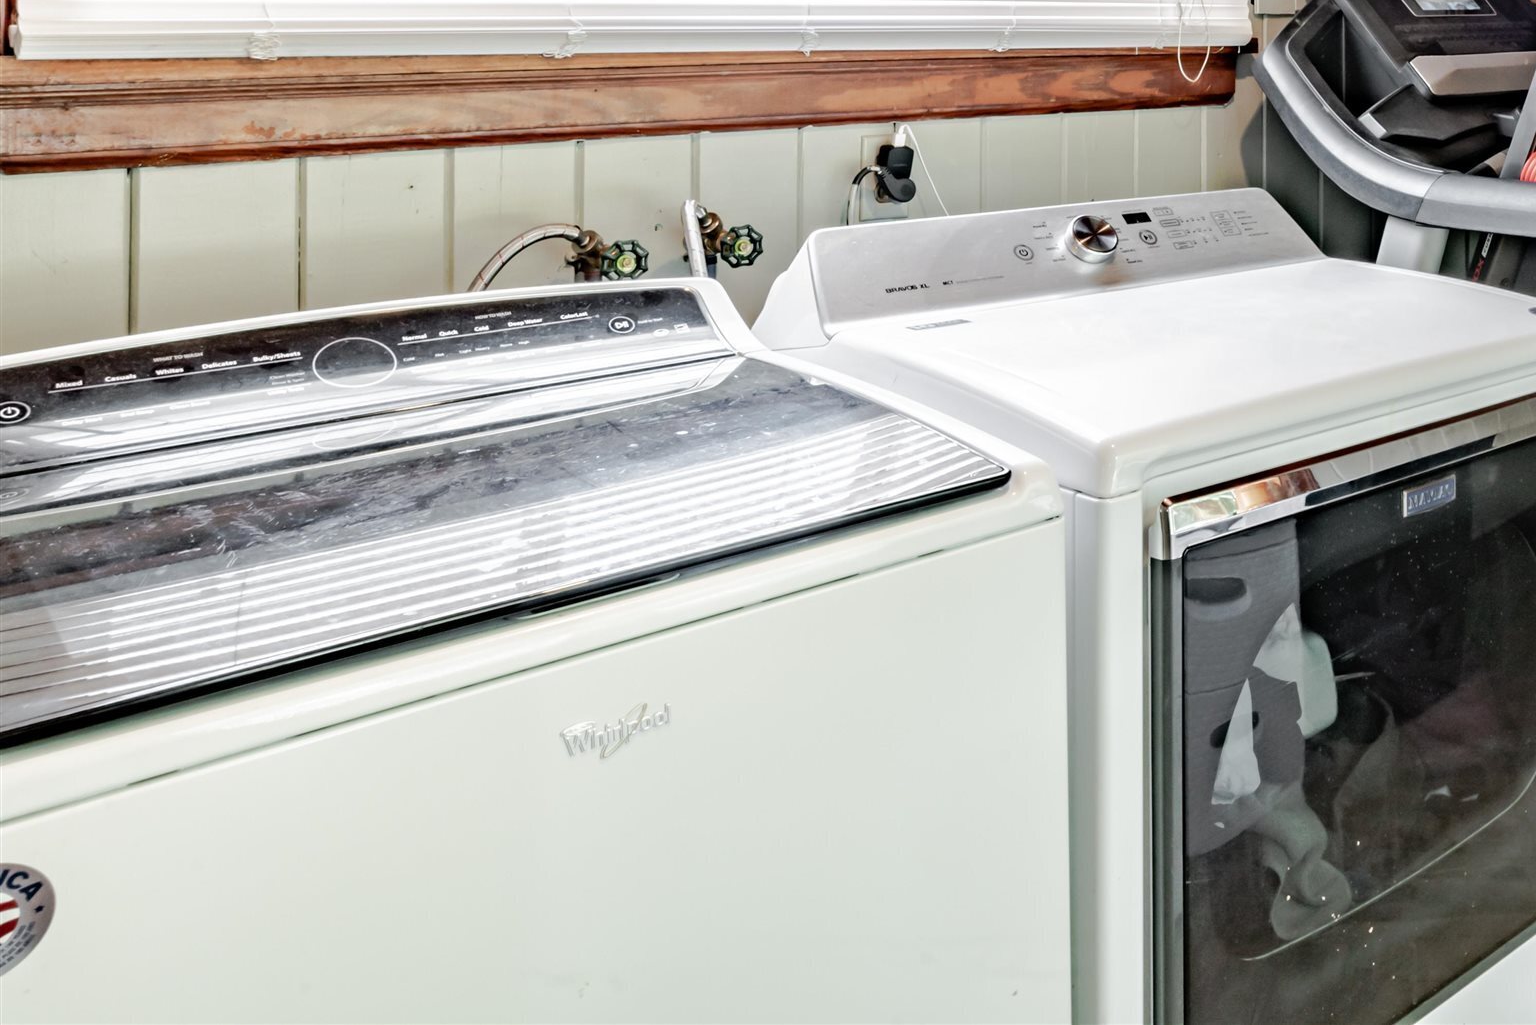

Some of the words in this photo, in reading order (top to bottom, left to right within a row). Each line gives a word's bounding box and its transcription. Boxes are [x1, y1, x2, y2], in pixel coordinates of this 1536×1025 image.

[885, 284, 918, 294] BRAVOS
[402, 332, 427, 342] Normal
[438, 328, 459, 337] Quick
[474, 325, 490, 333] Cold
[507, 320, 524, 328] Deep
[525, 317, 543, 325] Water
[55, 379, 83, 389] Mixed
[104, 373, 137, 383] Casuals
[155, 366, 184, 375] Whites
[201, 359, 238, 370] Delicates
[559, 702, 672, 759] Whirlpool
